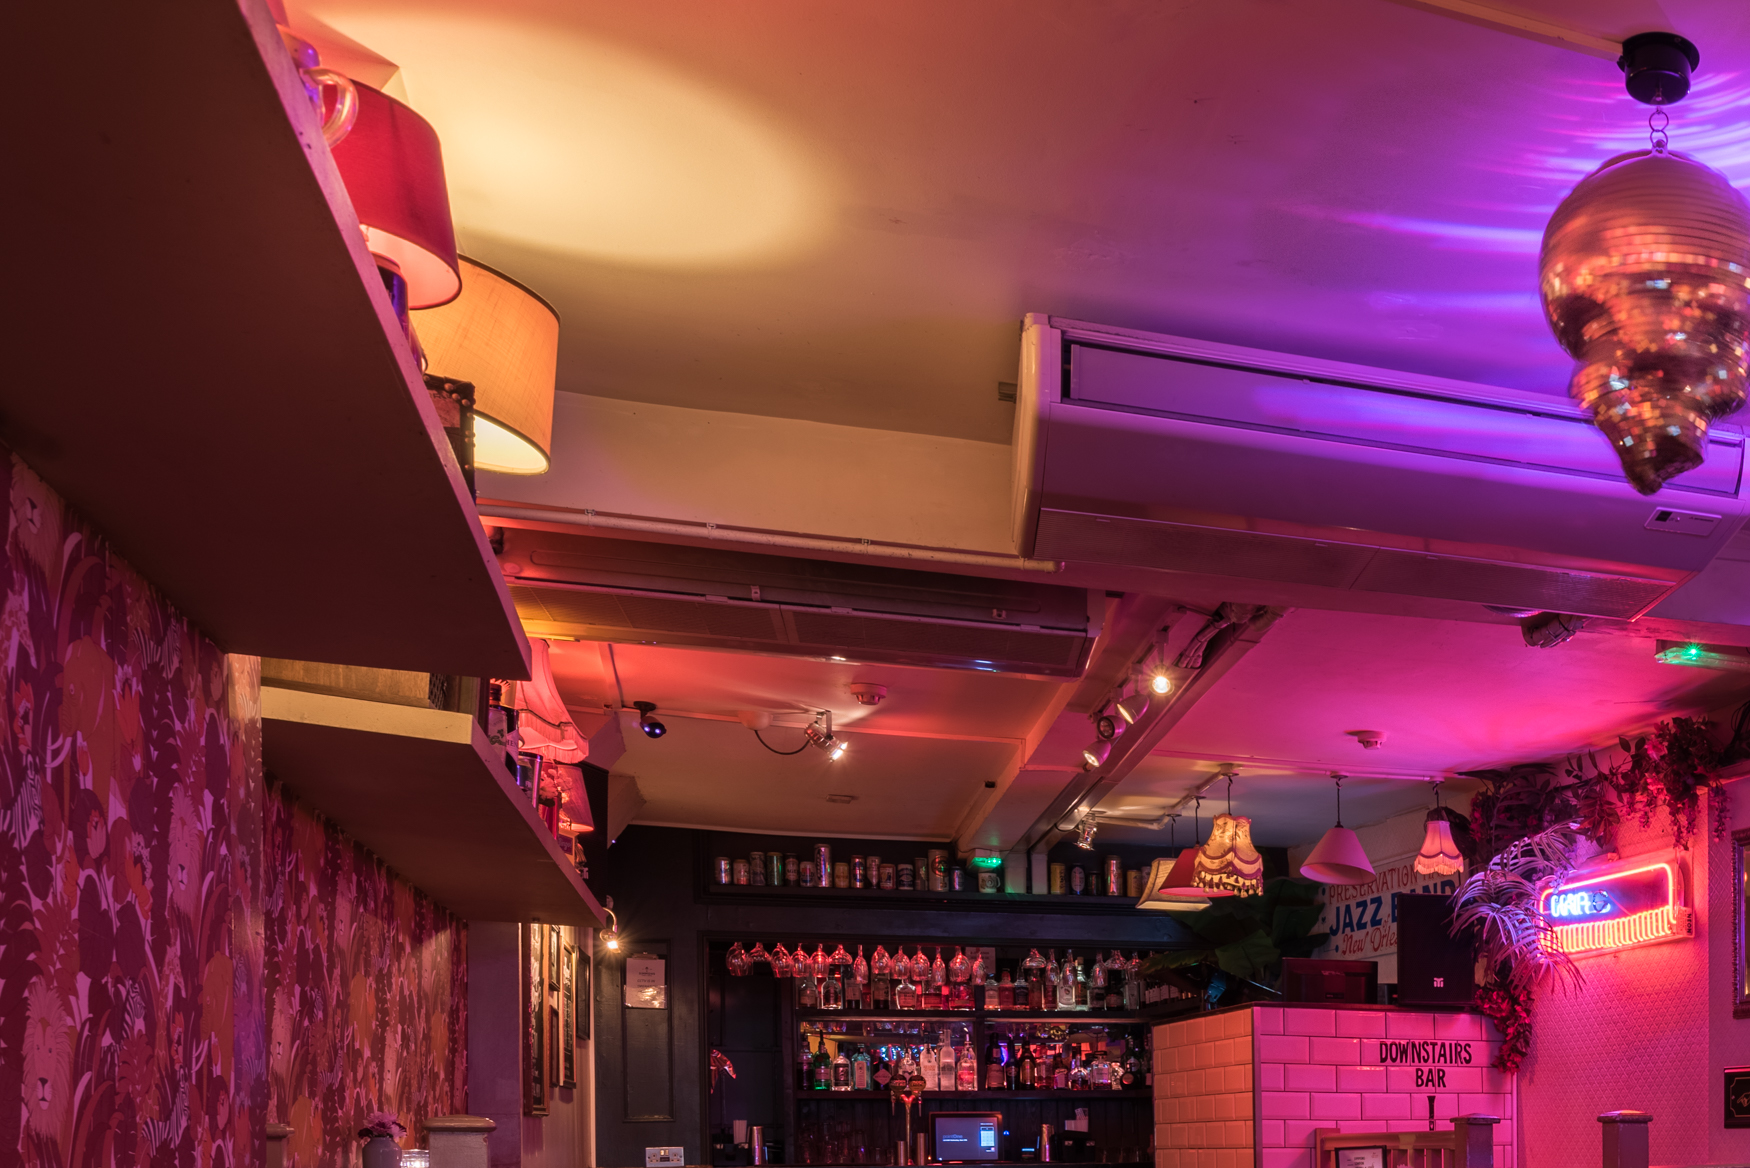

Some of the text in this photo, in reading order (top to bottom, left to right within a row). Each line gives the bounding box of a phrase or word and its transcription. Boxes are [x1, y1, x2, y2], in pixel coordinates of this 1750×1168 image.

[1329, 896, 1383, 936] JAZZ
[1342, 930, 1369, 956] New
[1380, 1041, 1472, 1064] DOWNSTAIRS
[1416, 1068, 1446, 1087] BAR
